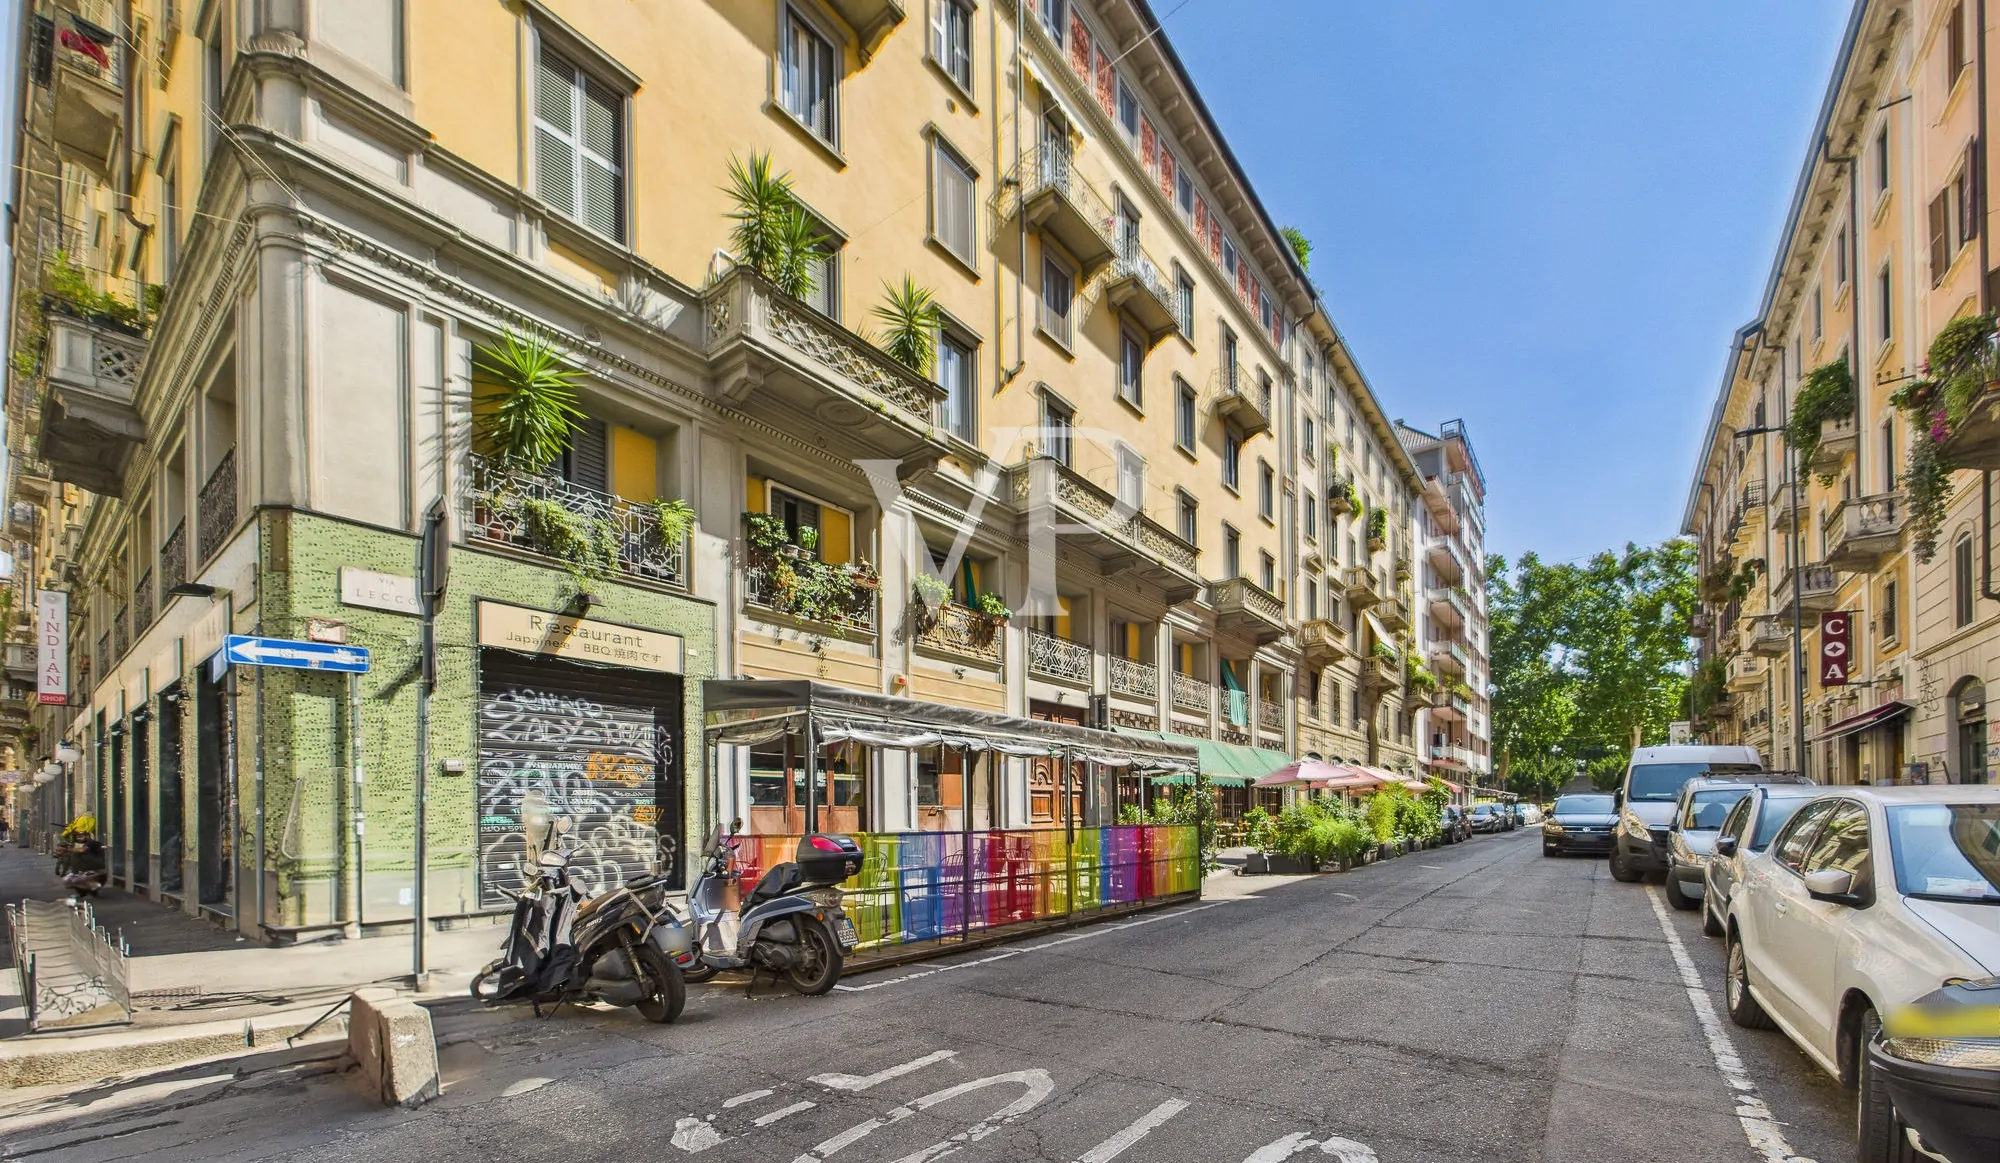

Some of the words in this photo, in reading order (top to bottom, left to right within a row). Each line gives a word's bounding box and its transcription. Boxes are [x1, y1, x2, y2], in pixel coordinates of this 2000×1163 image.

[379, 578, 395, 586] VIA
[356, 588, 417, 606] LECCO
[506, 632, 571, 649] Japanese
[584, 644, 611, 656] BBQ
[530, 615, 643, 647] Restaurant
[45, 608, 61, 686] INDIAN
[1824, 619, 1846, 679] COA
